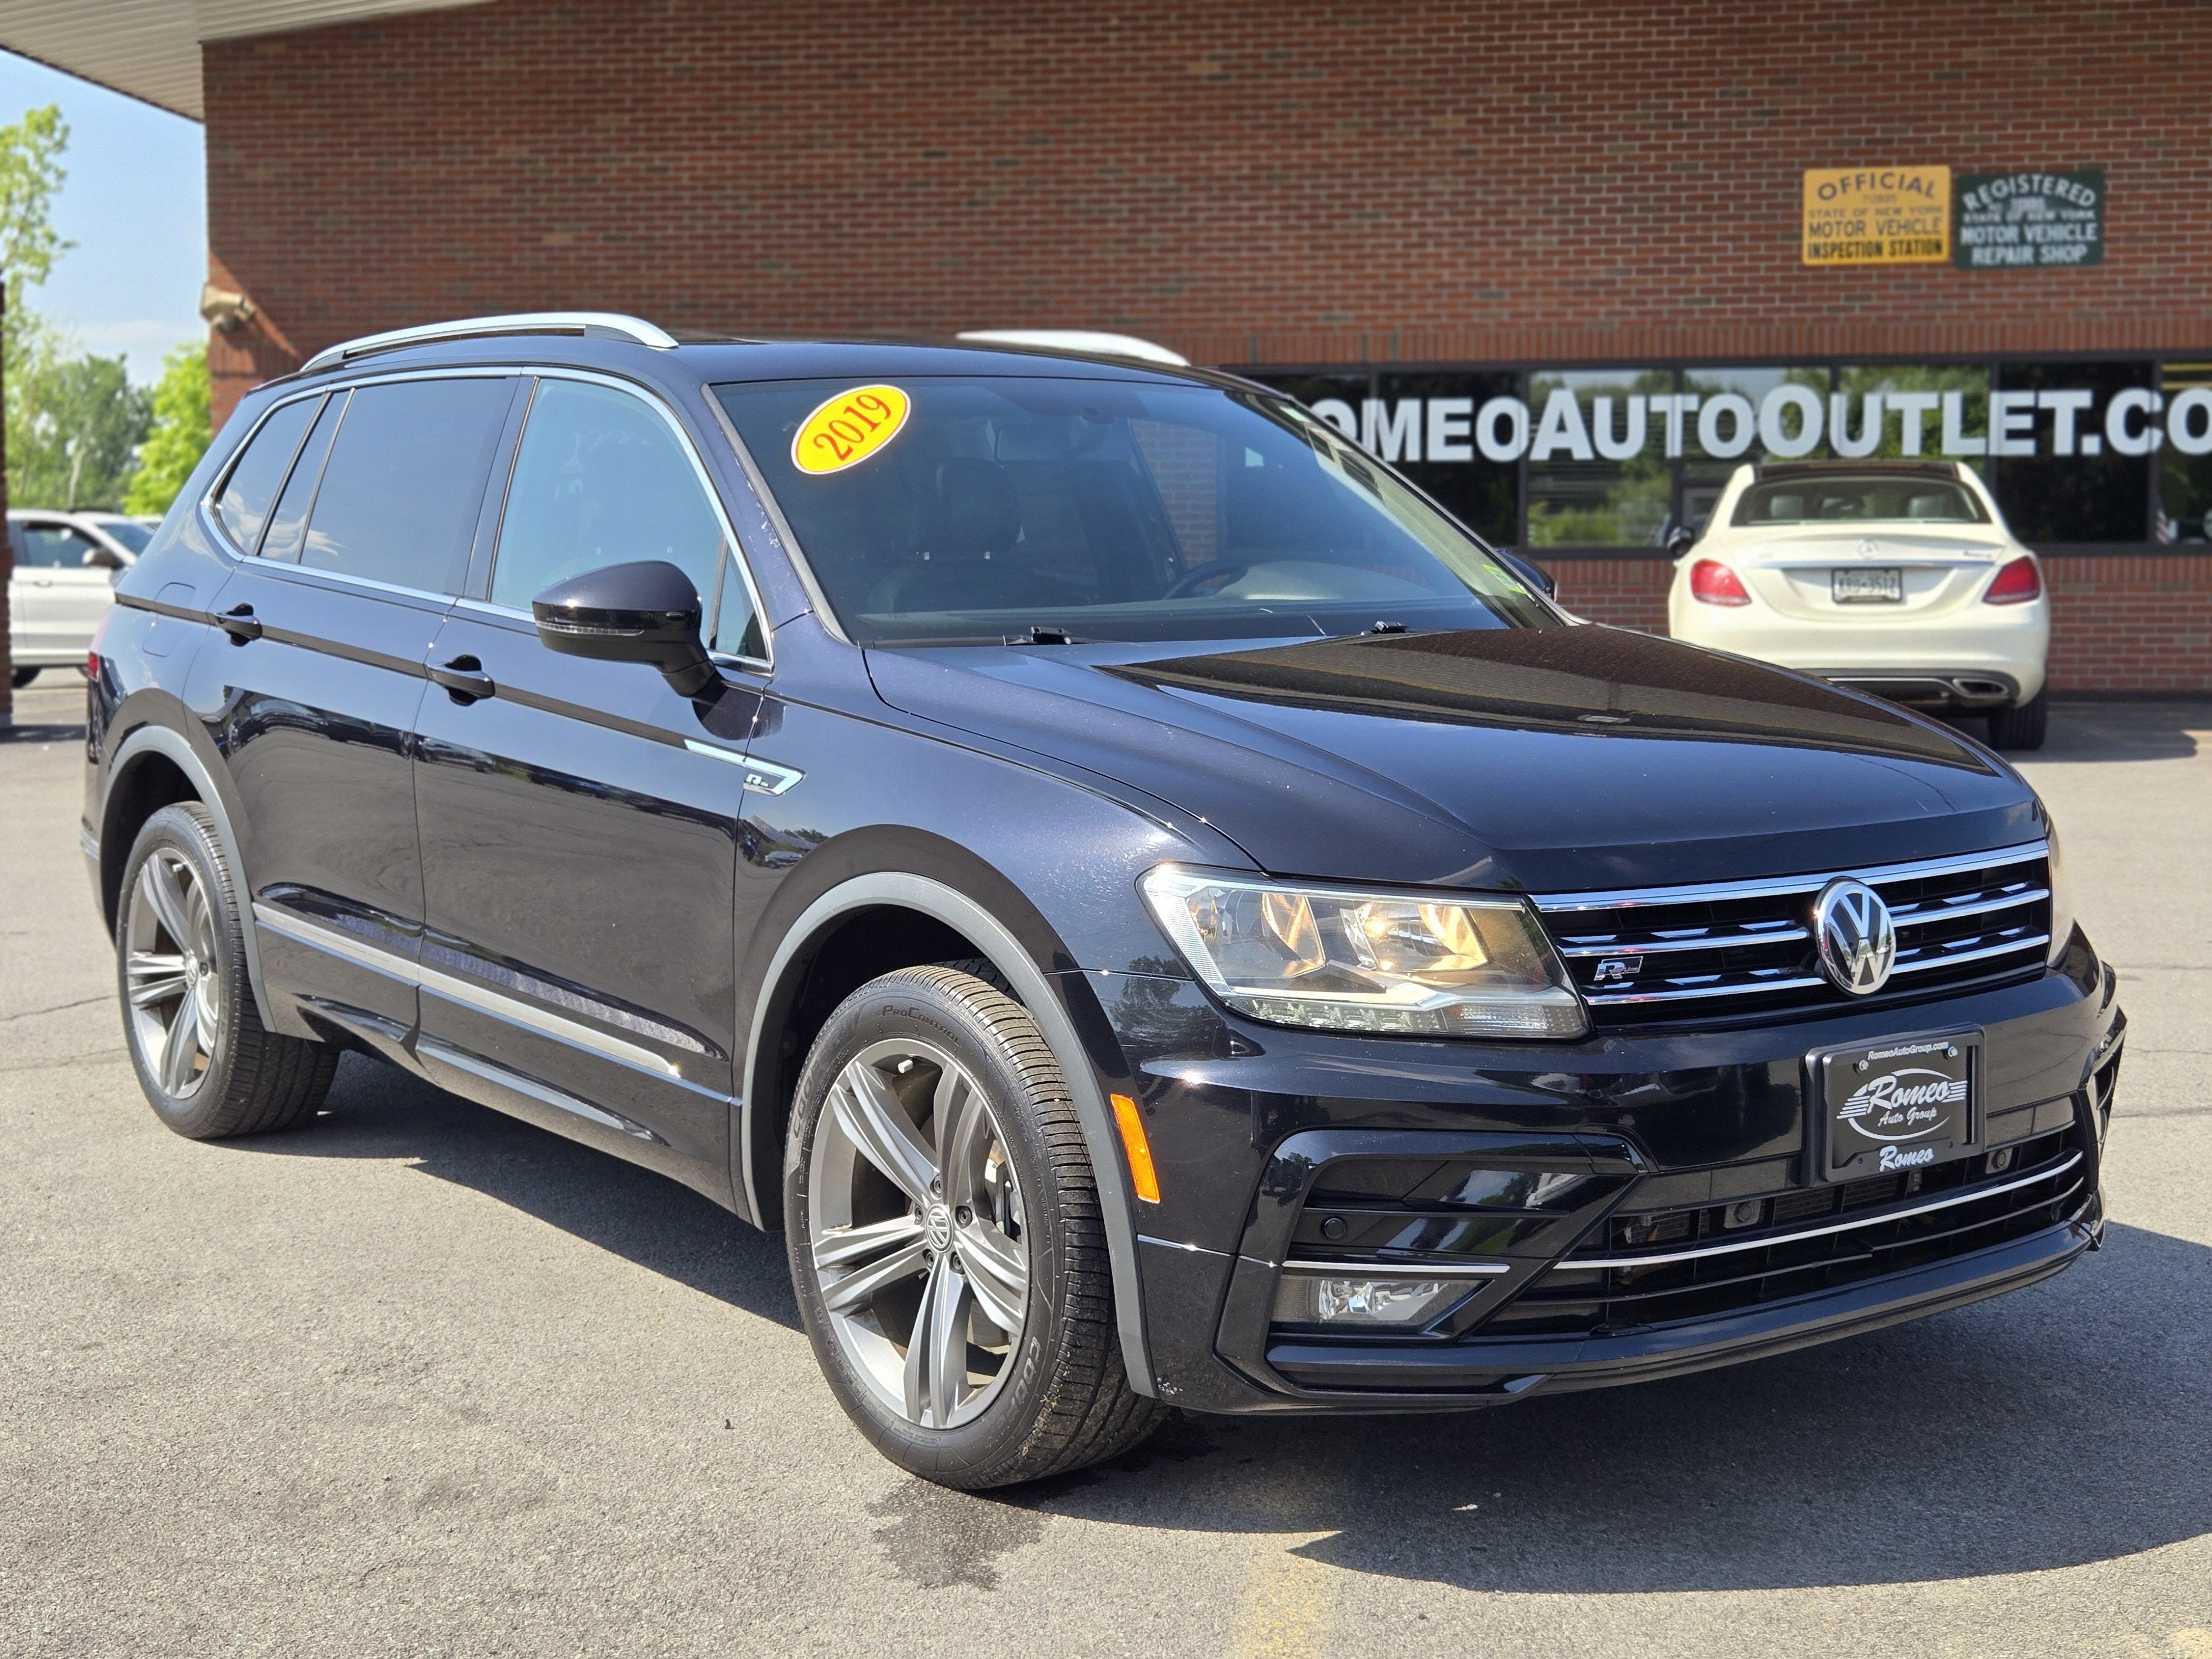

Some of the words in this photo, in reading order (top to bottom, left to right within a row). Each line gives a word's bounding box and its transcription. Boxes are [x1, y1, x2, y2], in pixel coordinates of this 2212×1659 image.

[1817, 172, 1934, 201] OFFICIAL
[1962, 174, 2096, 211] REGISTERED
[1808, 207, 1845, 218] STATE
[1809, 220, 1866, 238] MOTOR
[1875, 217, 1943, 237] VEHICLE
[1960, 224, 2019, 246] MOTOR
[2023, 222, 2098, 243] VEHICLE
[1808, 239, 1884, 259] INSPECTION
[1888, 238, 1943, 257] STATION
[1972, 244, 2035, 266] REPAIR
[2040, 243, 2088, 264] SHOP
[813, 394, 891, 461] 2019
[1867, 1041, 1949, 1061] RomeoAutoGroup.com
[1866, 1075, 1951, 1114] Romeo
[1877, 1110, 1904, 1126] Auto
[1906, 1106, 1937, 1126] Group
[1879, 1145, 1934, 1172] Romeo
